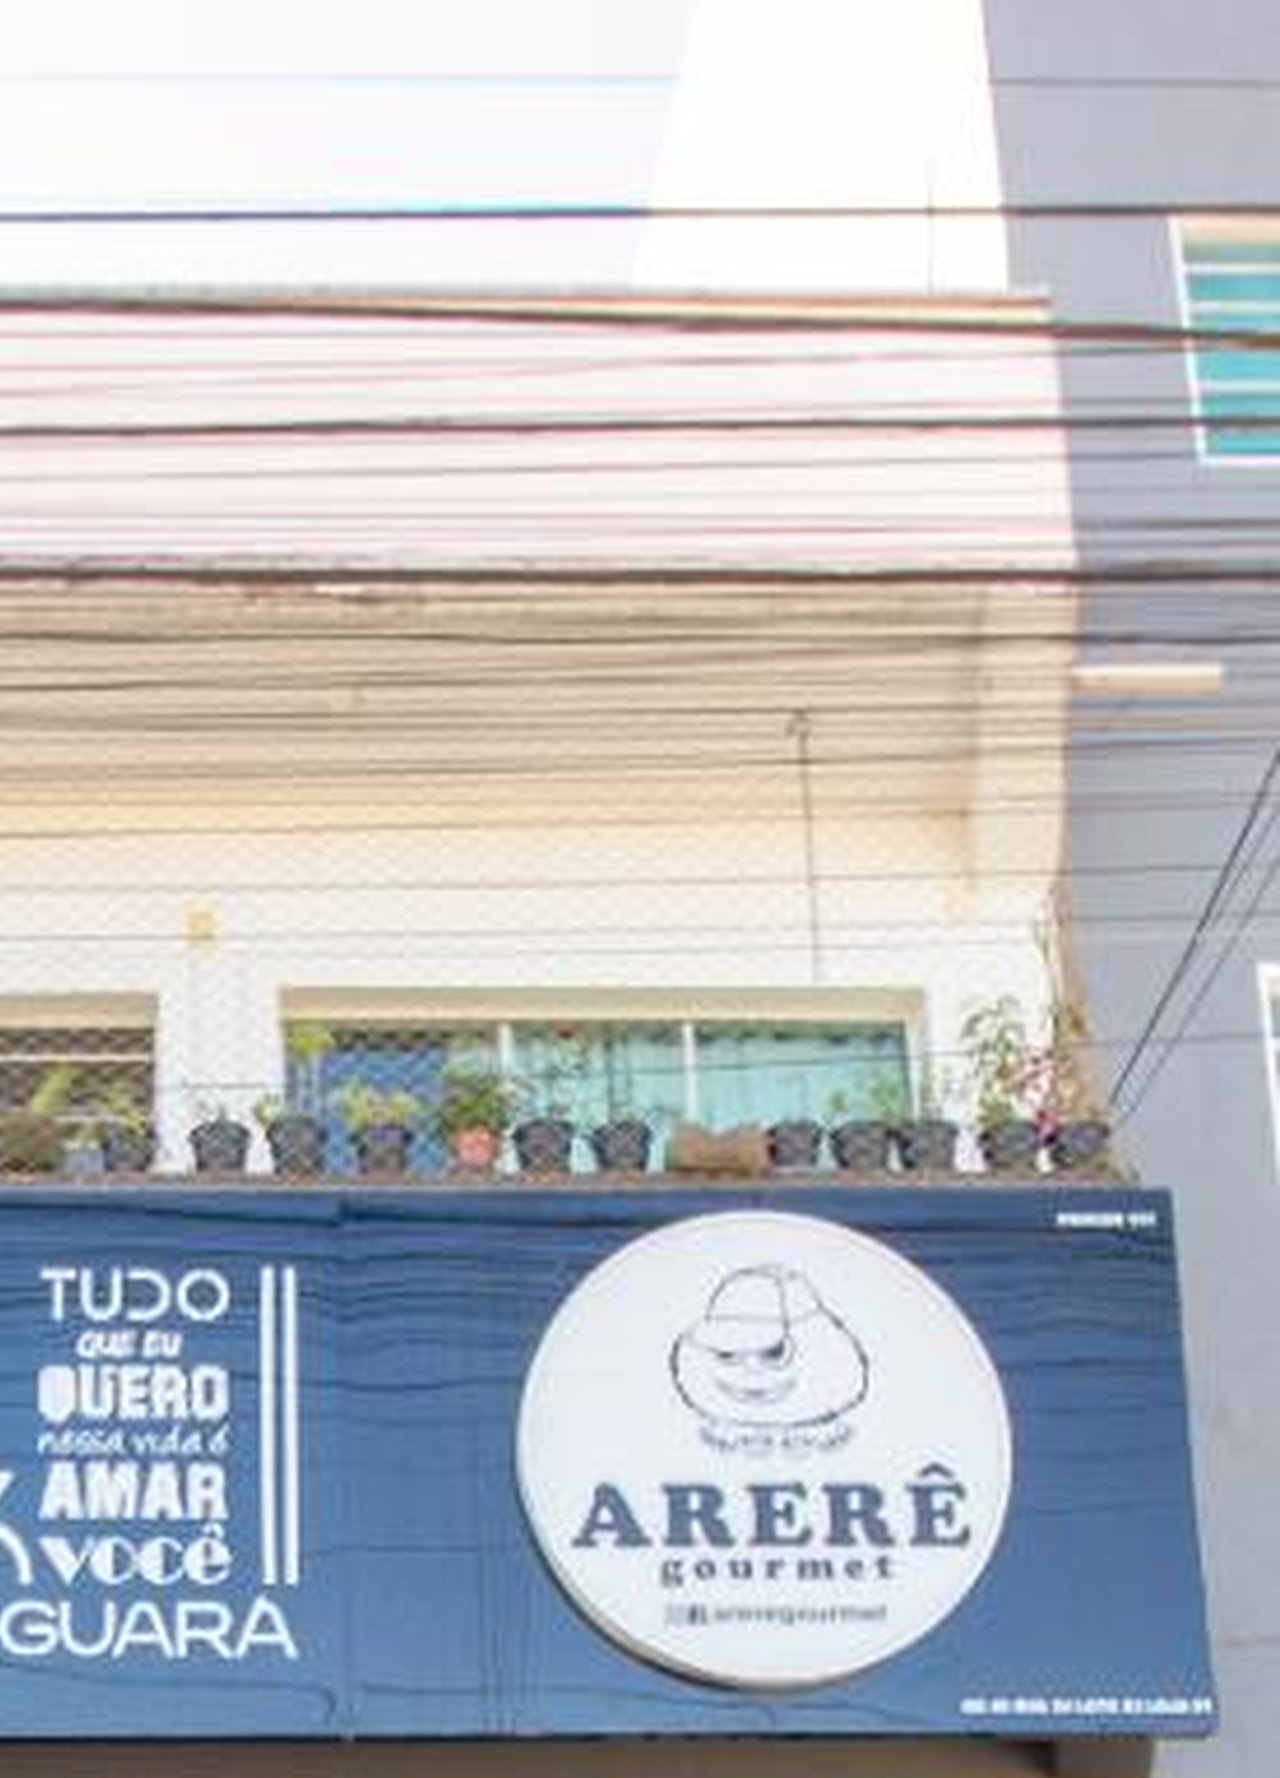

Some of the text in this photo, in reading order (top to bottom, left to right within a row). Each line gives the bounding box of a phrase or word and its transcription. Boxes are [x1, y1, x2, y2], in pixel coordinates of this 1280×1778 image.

[40, 1267, 230, 1321] TUDO
[38, 1364, 229, 1422] QUERO
[39, 1460, 229, 1520] AMAR
[570, 1462, 971, 1549] ARERÊ
[659, 1554, 897, 1588] gourmet
